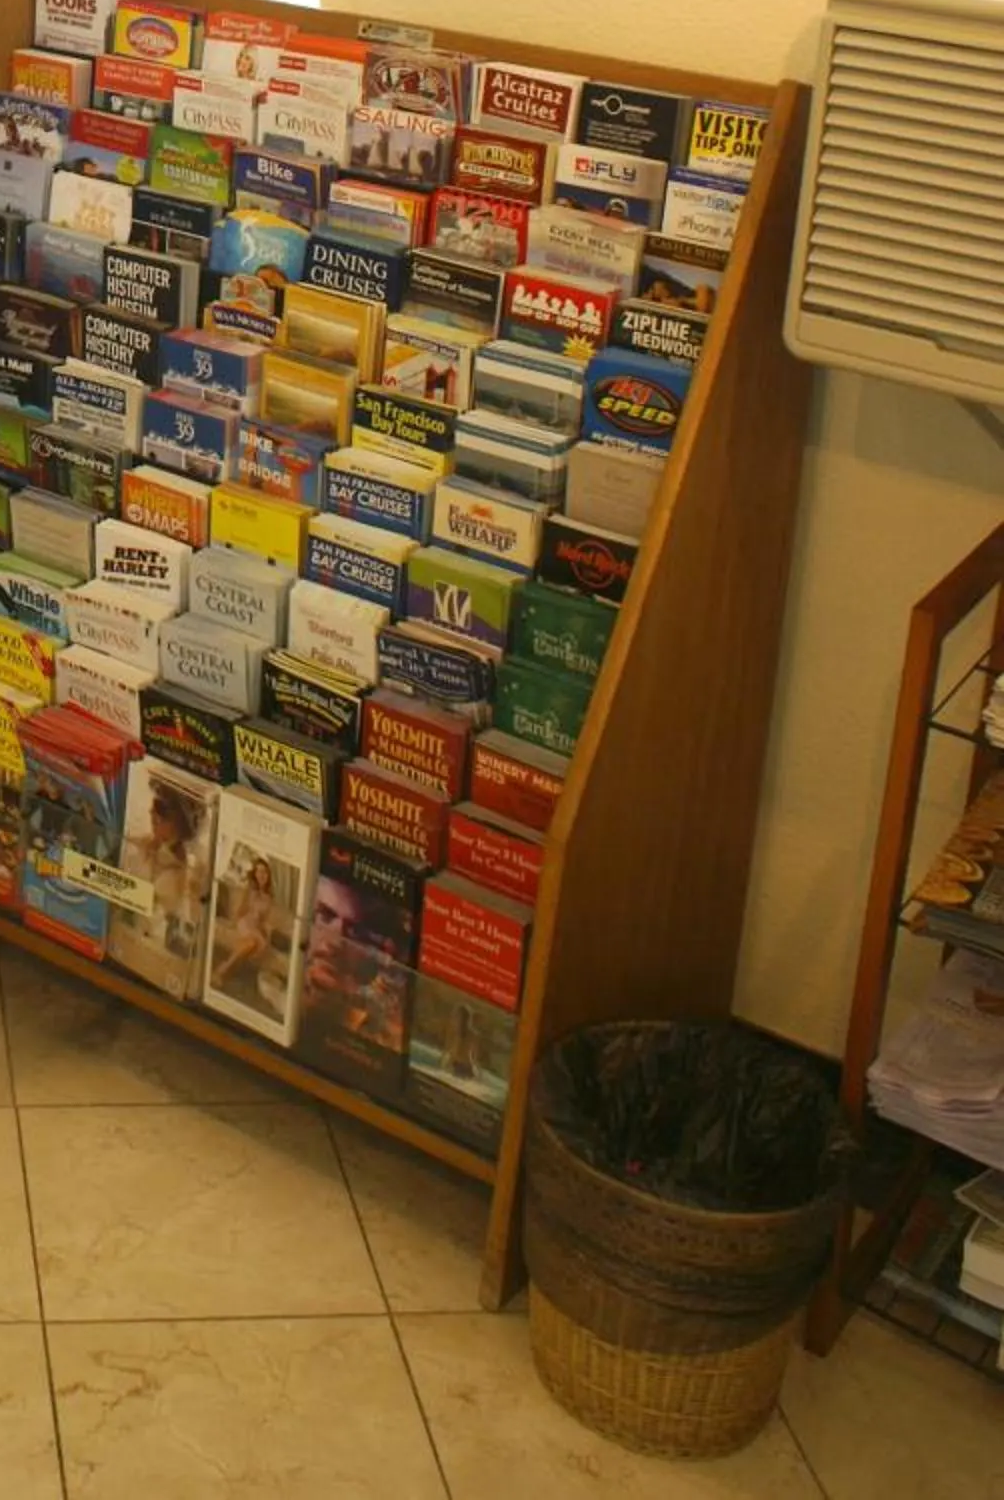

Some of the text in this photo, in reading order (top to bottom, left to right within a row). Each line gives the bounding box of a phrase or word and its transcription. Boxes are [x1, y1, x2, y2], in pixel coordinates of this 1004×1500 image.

[491, 71, 563, 105] Alcatraz
[355, 107, 446, 136] SAILING
[493, 92, 557, 122] Cruises
[695, 136, 762, 159] TIPS ON
[257, 157, 294, 182] Bike
[107, 256, 171, 288] COMPUTER
[313, 244, 388, 280] DINING
[107, 276, 156, 304] HISTORY
[310, 267, 386, 301] CRUISES
[85, 314, 151, 350] COMPUTER
[622, 310, 691, 341] ZIPLINE
[8, 357, 34, 375] Mall
[85, 335, 135, 365] HISTORY
[195, 360, 214, 380] 39
[357, 391, 445, 434] San Francisco
[596, 396, 677, 426] SPEED
[176, 423, 195, 443] 39
[371, 414, 428, 444] Day Tours
[238, 456, 293, 490] BRIDGE
[329, 470, 411, 503] SAN FRANCISCO
[329, 483, 412, 518] BAY CRUISES
[144, 505, 189, 541] MAPS
[103, 558, 169, 579] HARLEY
[114, 546, 160, 564] RENT
[311, 540, 395, 576] SAN FRANCISCO
[310, 552, 394, 593] BAY CRUISES
[8, 578, 60, 615] Whale
[196, 573, 266, 613] CENTRAL
[205, 594, 254, 625] COAST
[167, 639, 235, 674] CENTRAL
[178, 658, 228, 688] COAST
[370, 708, 445, 756] YOSEMITE
[513, 713, 576, 750] Garden
[238, 731, 319, 775] WHALE
[477, 750, 529, 781] WINERY
[238, 751, 317, 791] WATCHING
[349, 774, 424, 824] YOSEMITE
